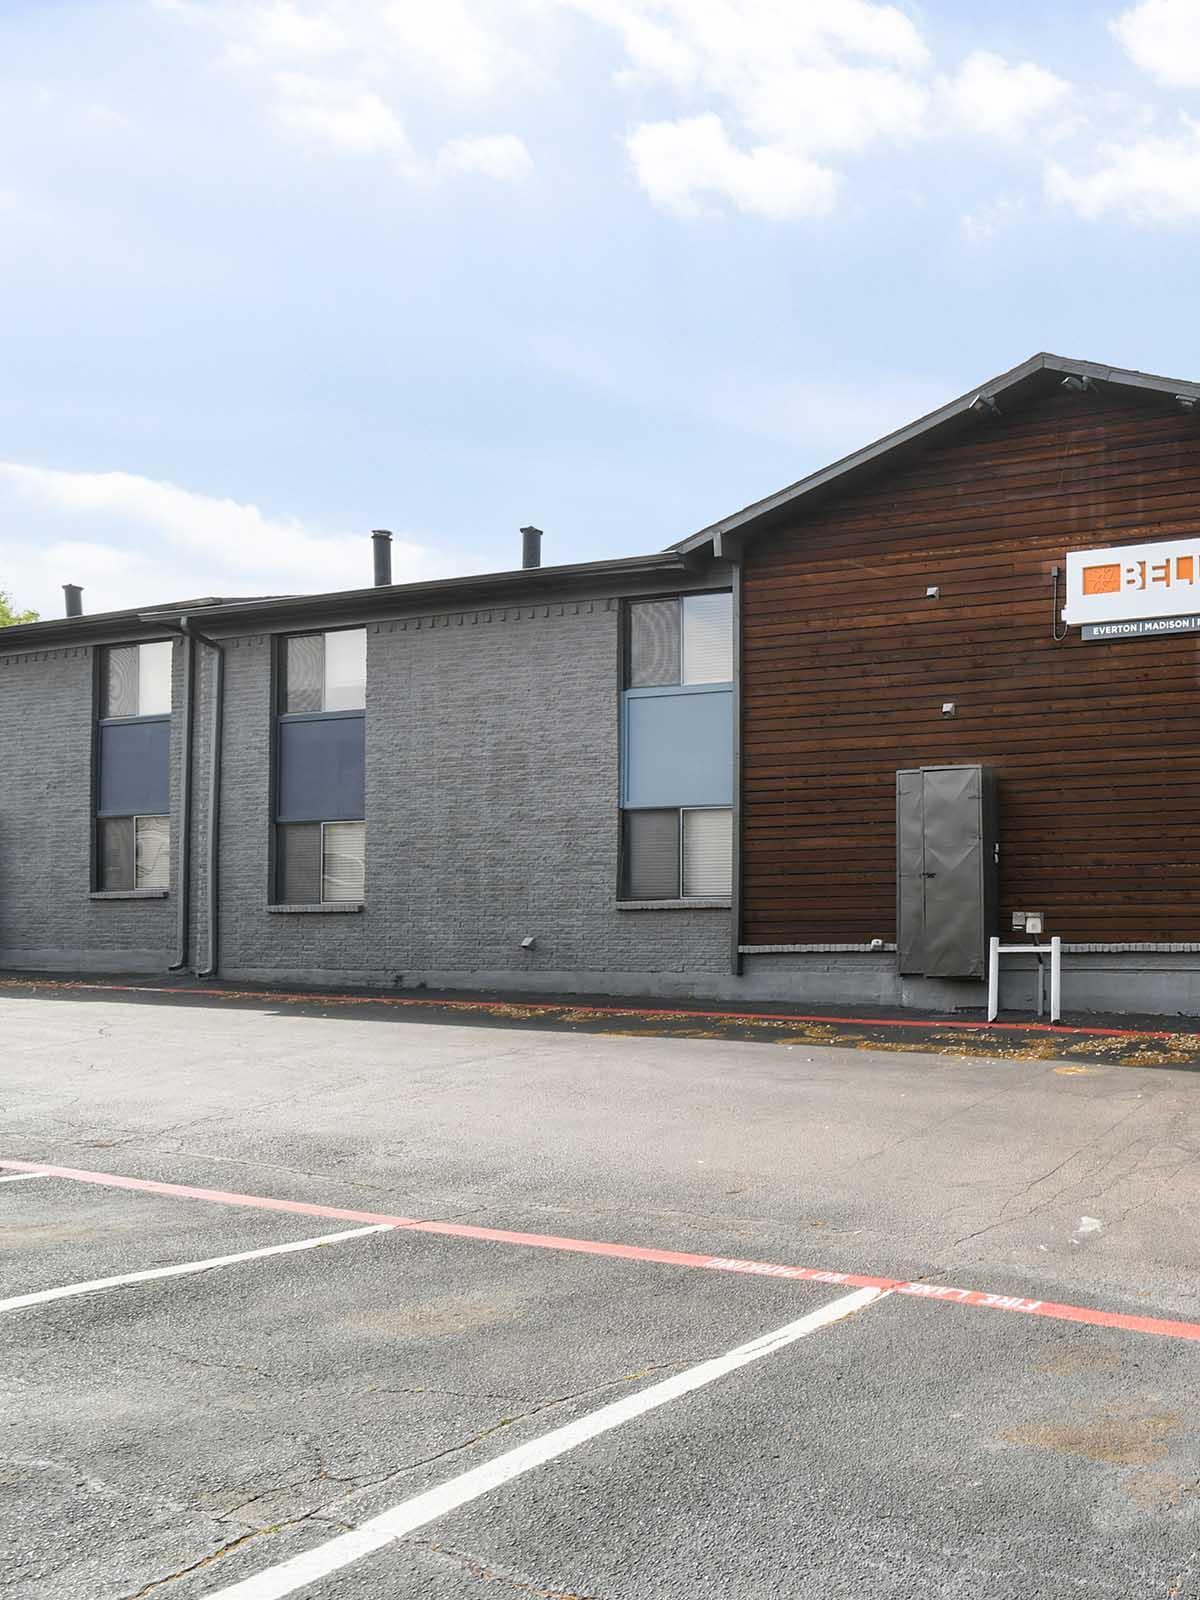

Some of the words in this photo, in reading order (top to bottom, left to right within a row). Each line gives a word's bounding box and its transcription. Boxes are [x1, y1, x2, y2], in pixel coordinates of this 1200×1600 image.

[1093, 624, 1137, 635] EVERTON
[1145, 619, 1189, 631] MADISON
[705, 1258, 807, 1277] PARKING
[811, 1271, 850, 1282] NO
[901, 1282, 972, 1299] LANE
[979, 1293, 1042, 1310] FIRE
